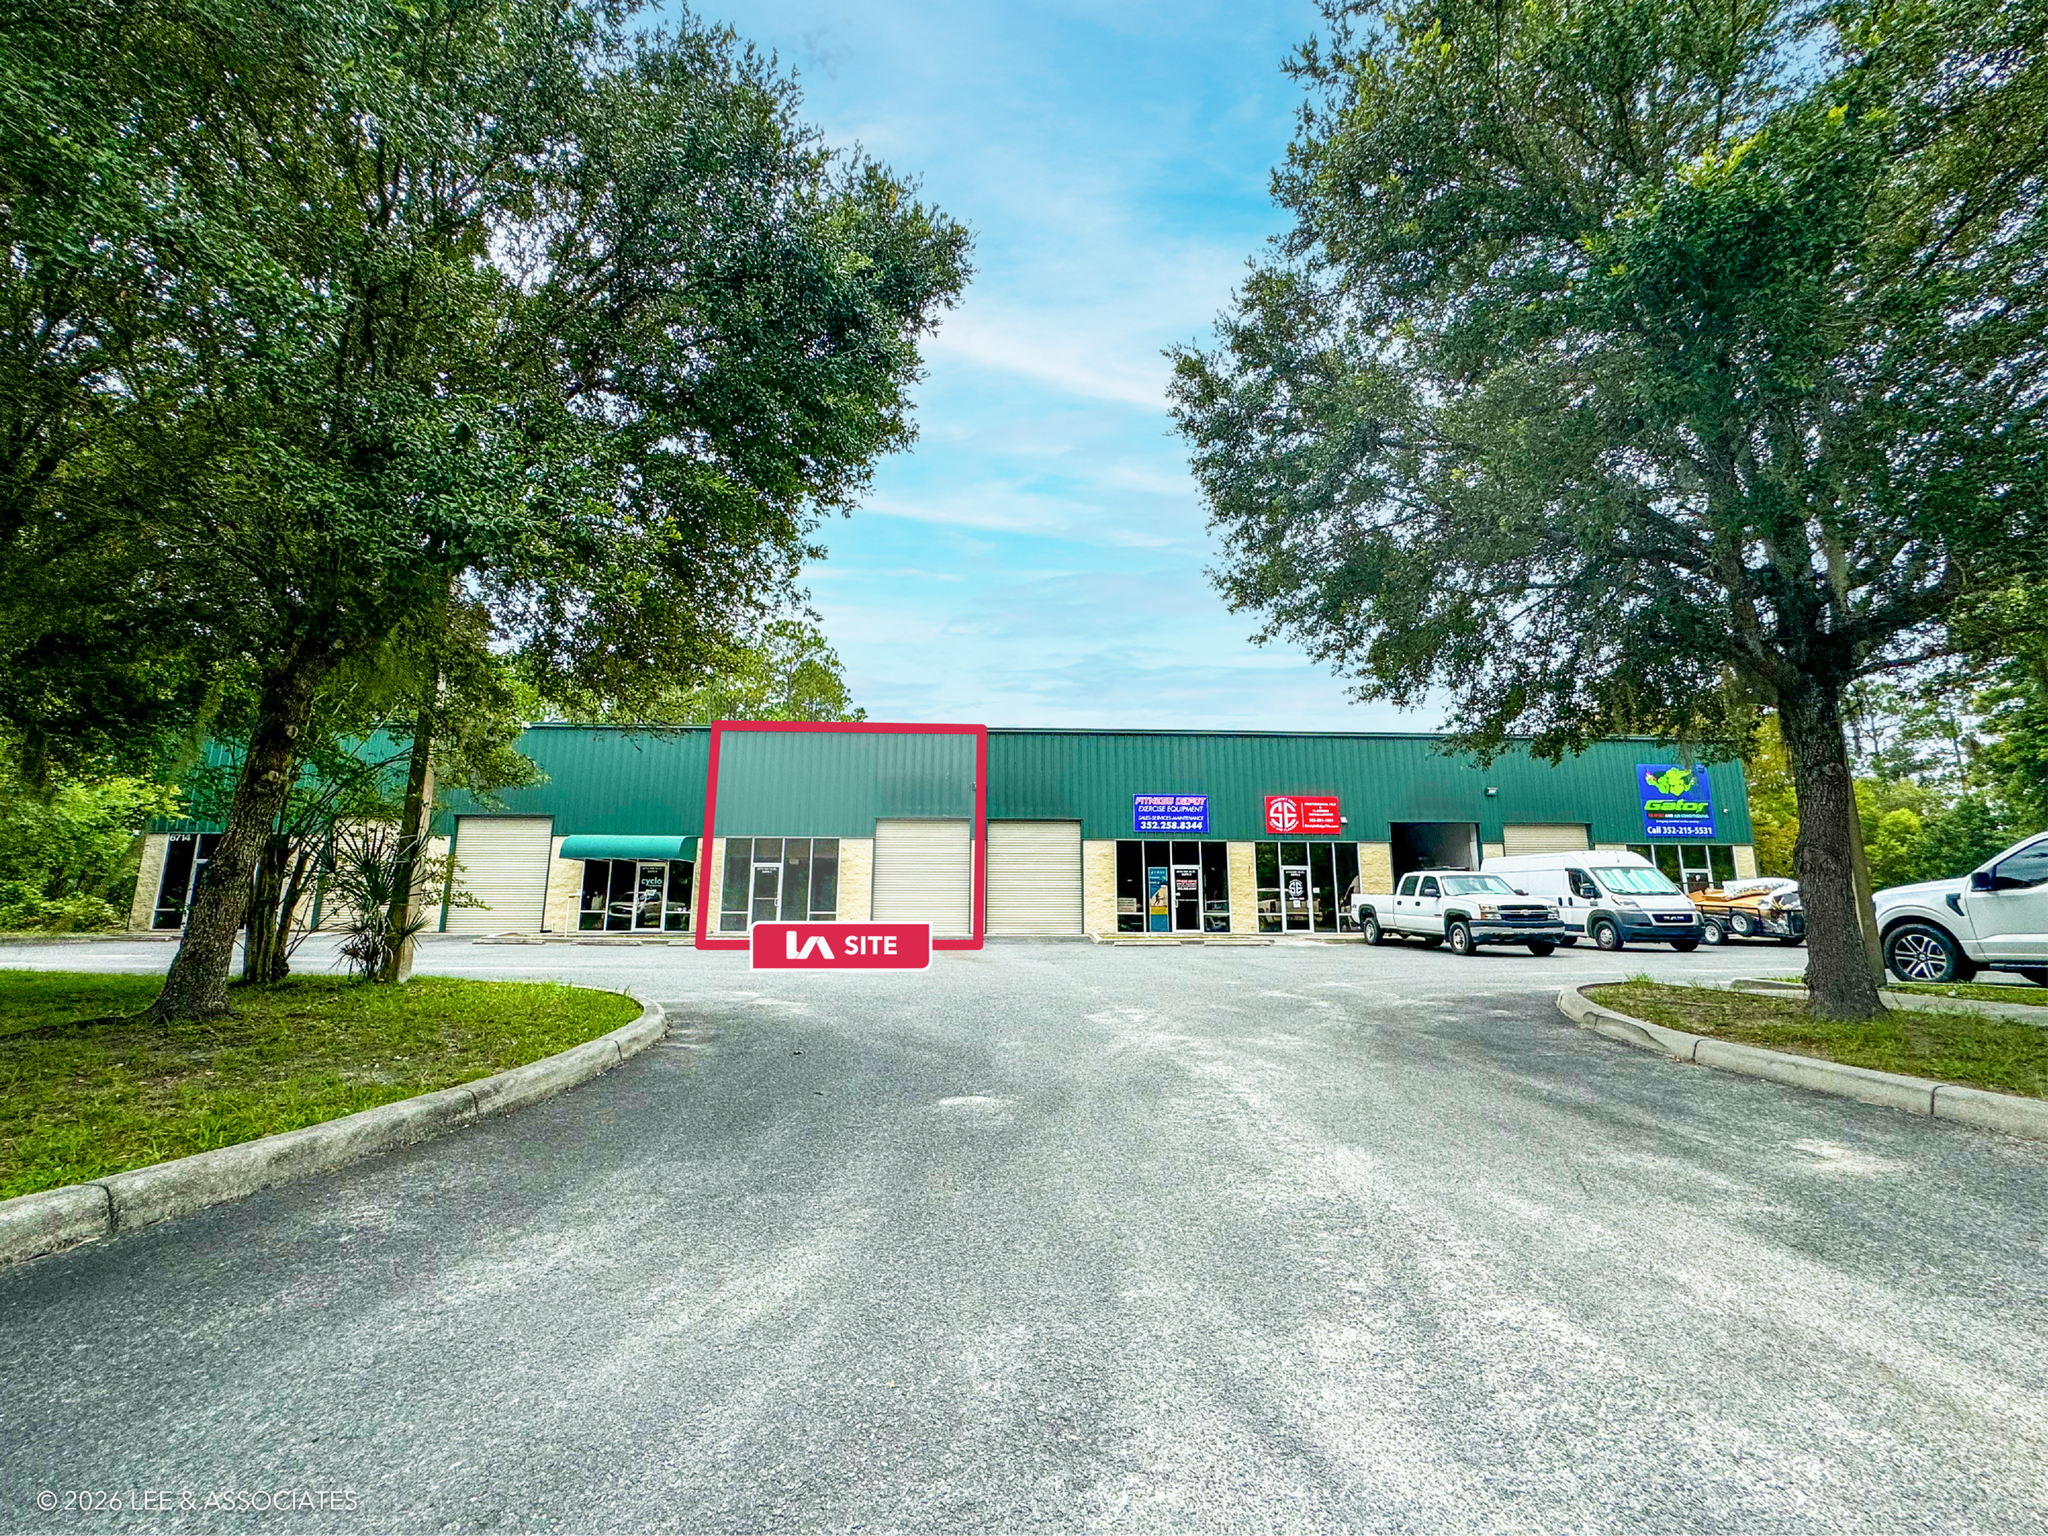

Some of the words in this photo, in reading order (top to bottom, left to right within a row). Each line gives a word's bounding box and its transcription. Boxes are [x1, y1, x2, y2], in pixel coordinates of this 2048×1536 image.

[1135, 797, 1174, 805] FITNESS
[1175, 797, 1206, 805] DEPOT
[1644, 798, 1708, 813] Gator
[1140, 821, 1203, 830] 352.258.8344
[1647, 826, 1661, 834] Call
[1662, 826, 1712, 835] 352-215-5531
[170, 833, 191, 841] 6714
[641, 876, 662, 886] cyclo
